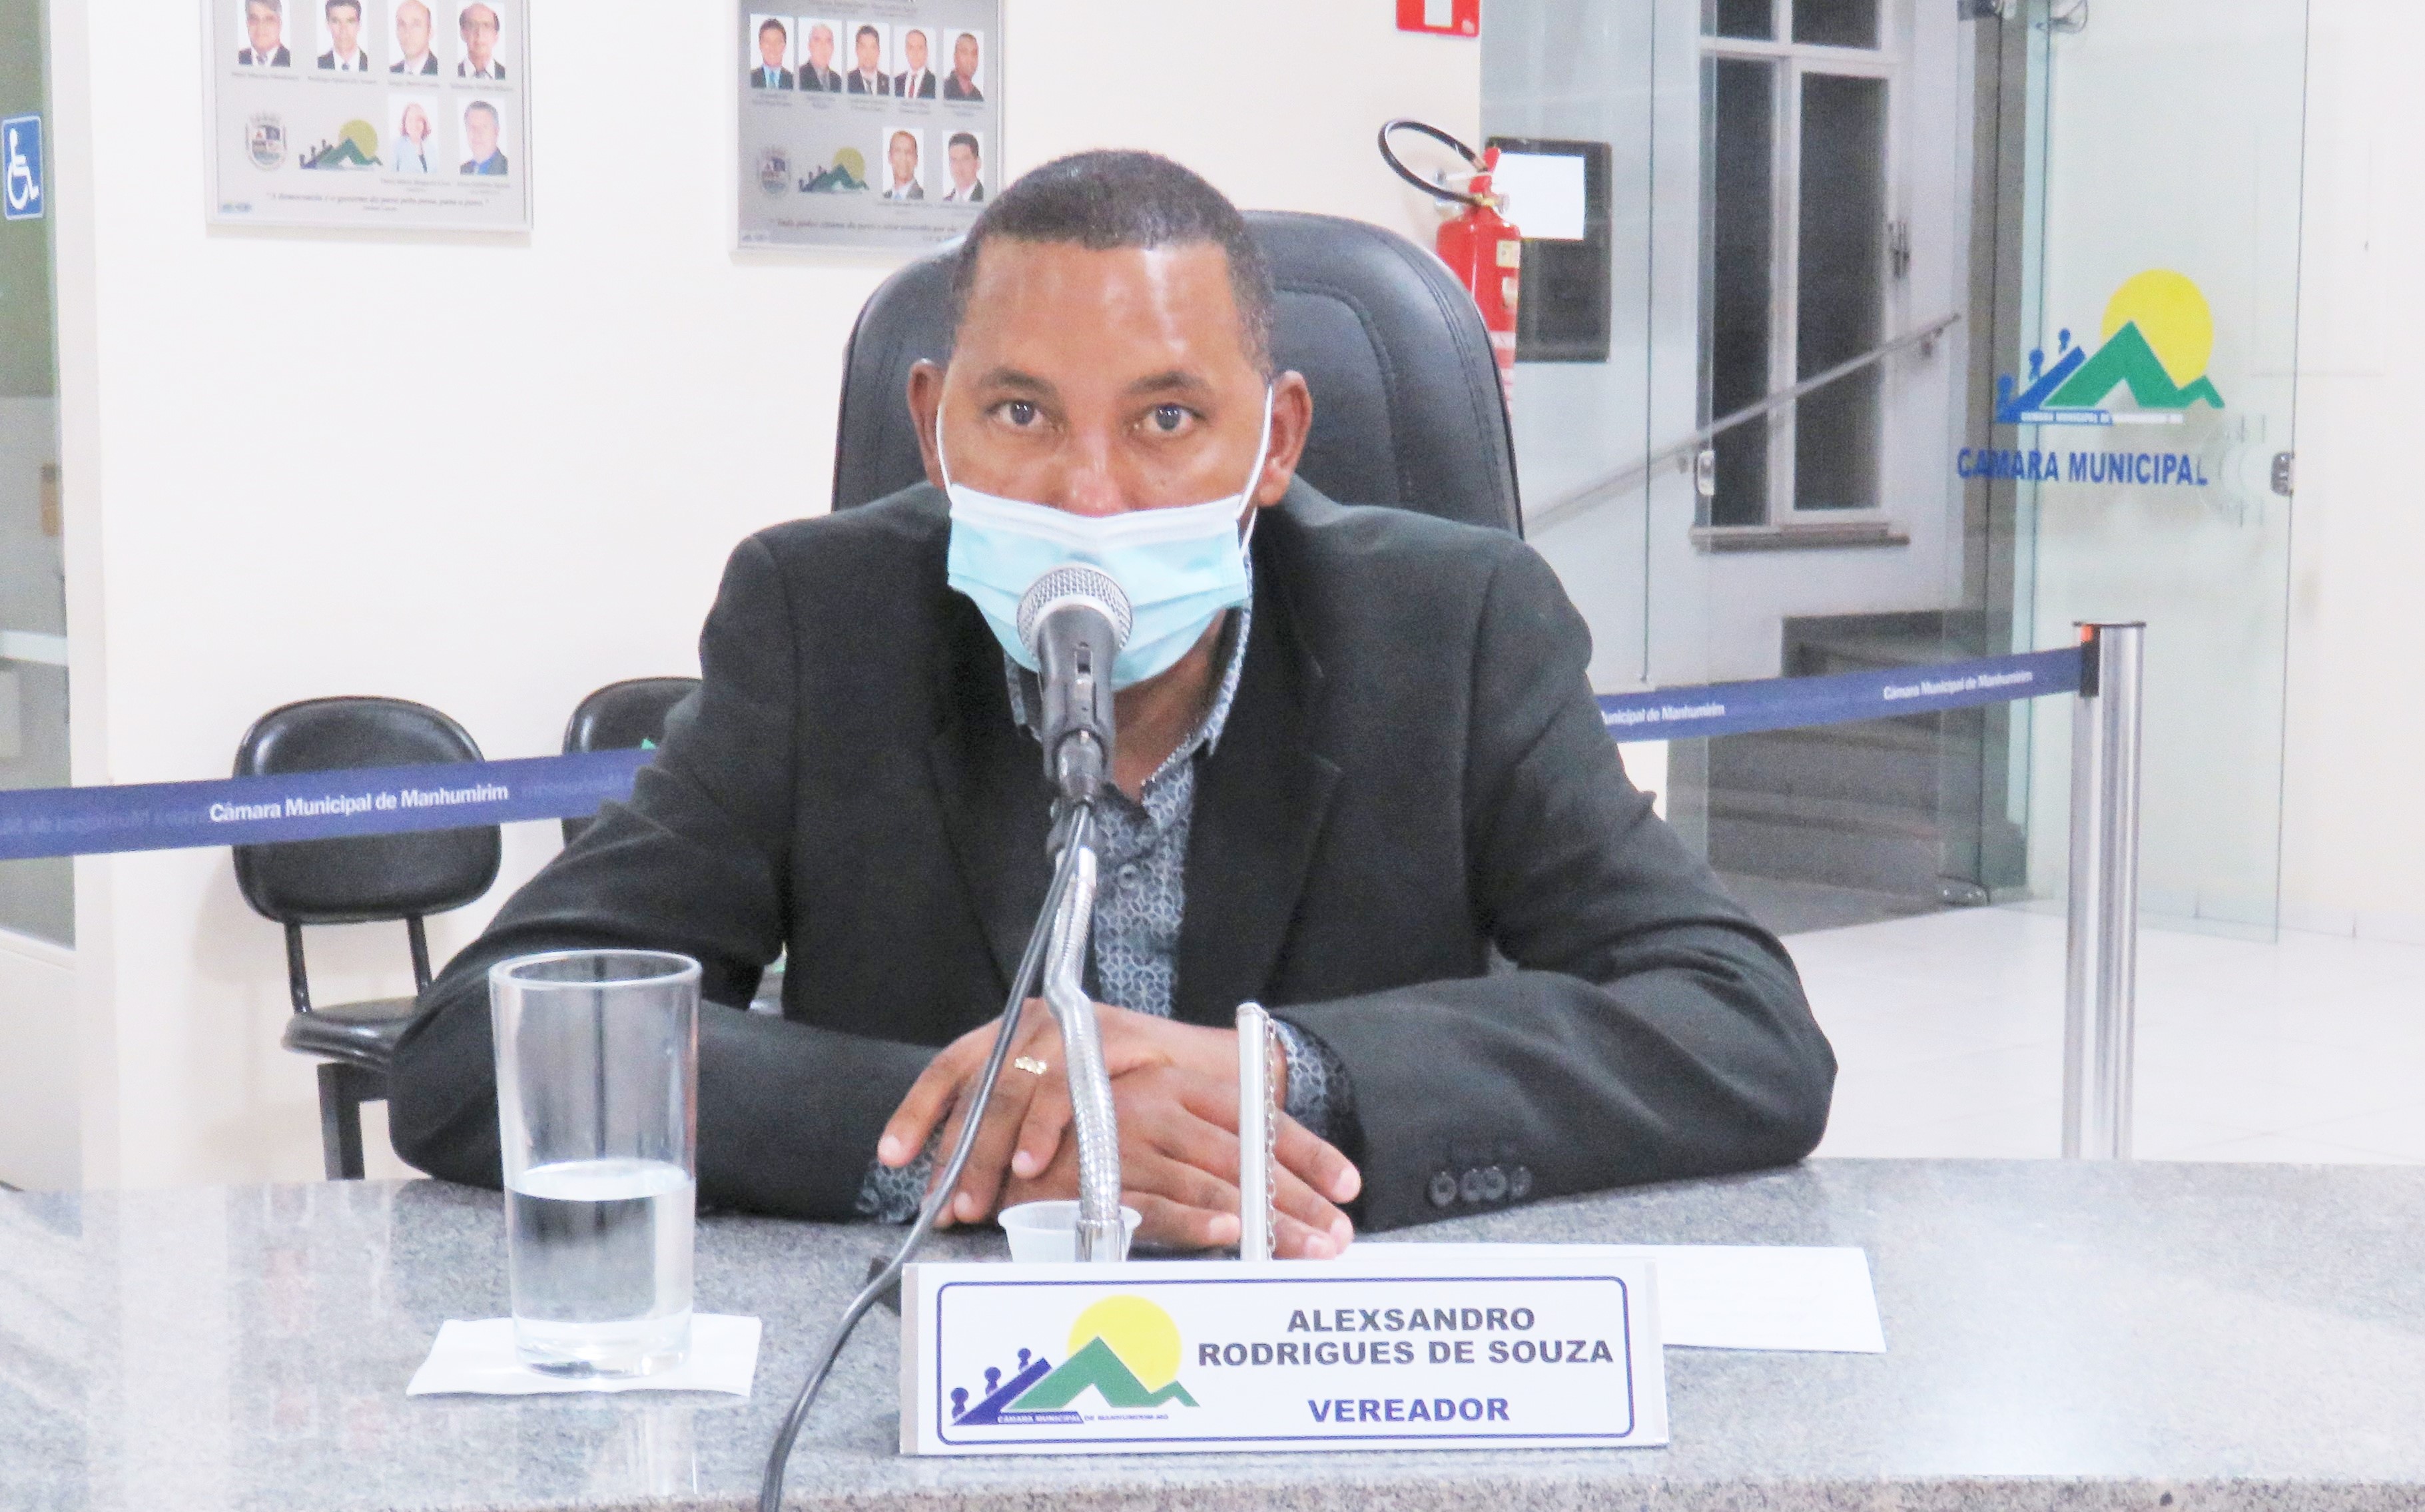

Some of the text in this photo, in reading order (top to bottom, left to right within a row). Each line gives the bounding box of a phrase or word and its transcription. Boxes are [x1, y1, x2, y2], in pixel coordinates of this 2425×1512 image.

[2068, 451, 2209, 486] MUNICIPAL
[209, 801, 281, 822] Câmara
[285, 793, 372, 817] Municipal
[375, 791, 398, 811] de
[401, 783, 509, 807] Manhumirim
[1287, 1307, 1535, 1333] ALEXSANDRO
[1198, 1339, 1614, 1366] RODRIGUES DE SOUZA
[1307, 1397, 1511, 1423] VEREADOR
